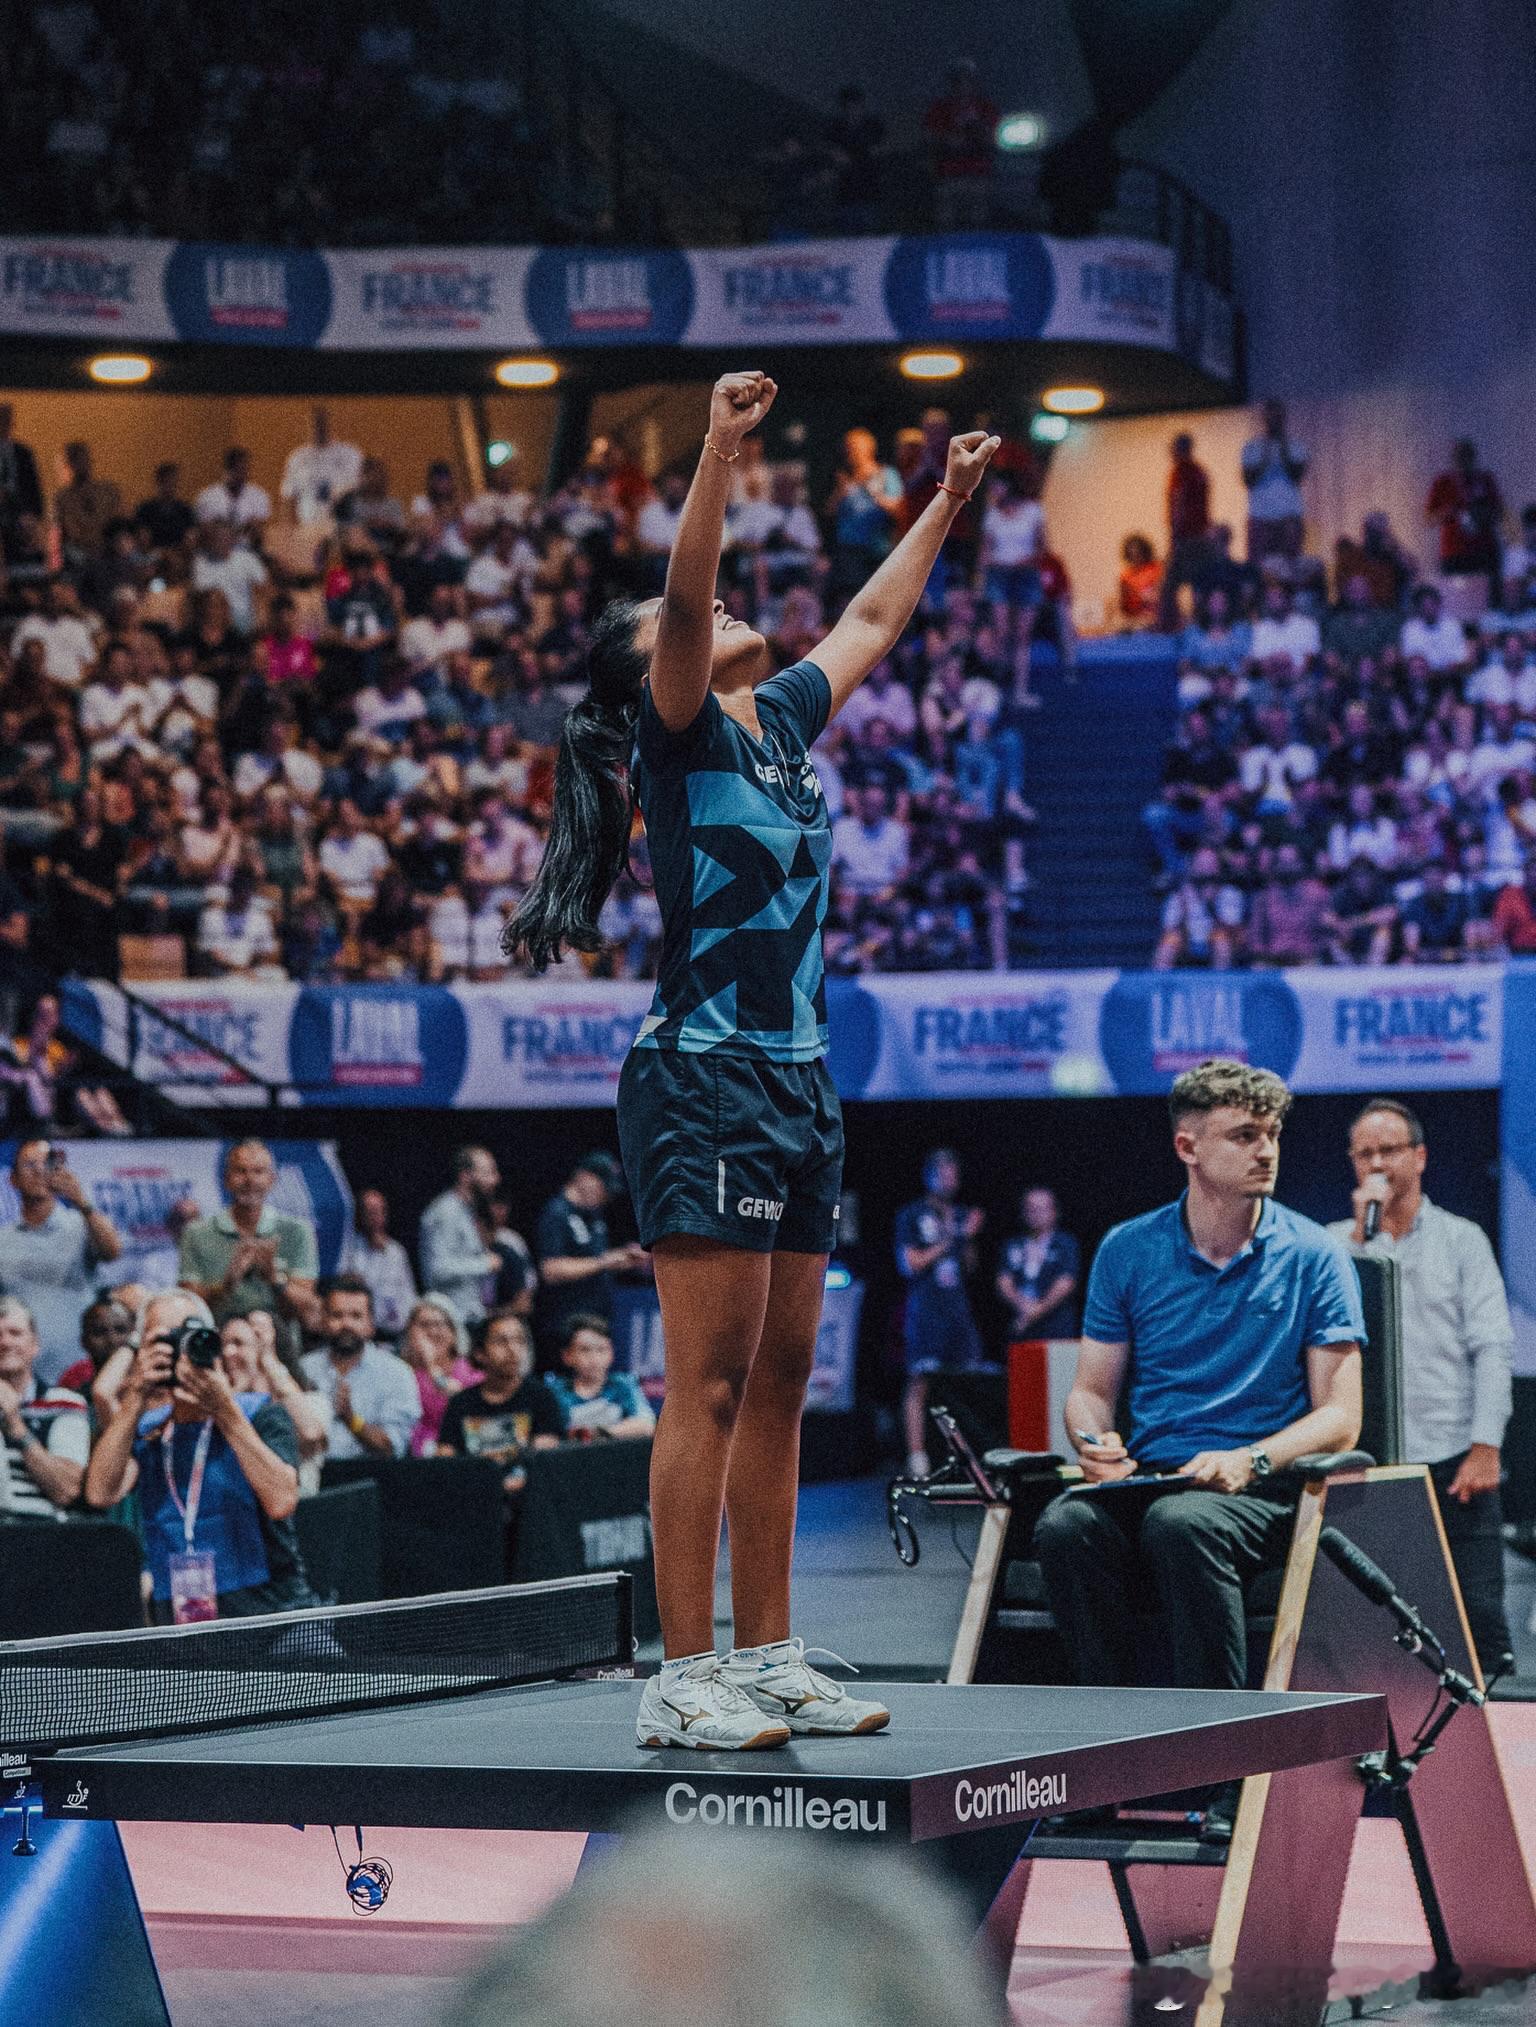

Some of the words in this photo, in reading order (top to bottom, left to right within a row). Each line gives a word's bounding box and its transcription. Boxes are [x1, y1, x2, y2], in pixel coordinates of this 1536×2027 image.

[913, 1000, 1068, 1054] FRANCE
[1335, 991, 1489, 1046] FRANCE
[737, 1196, 784, 1221] GEWO
[664, 1781, 887, 1832] Cornilleau
[954, 1769, 1067, 1822] Cornilleau
